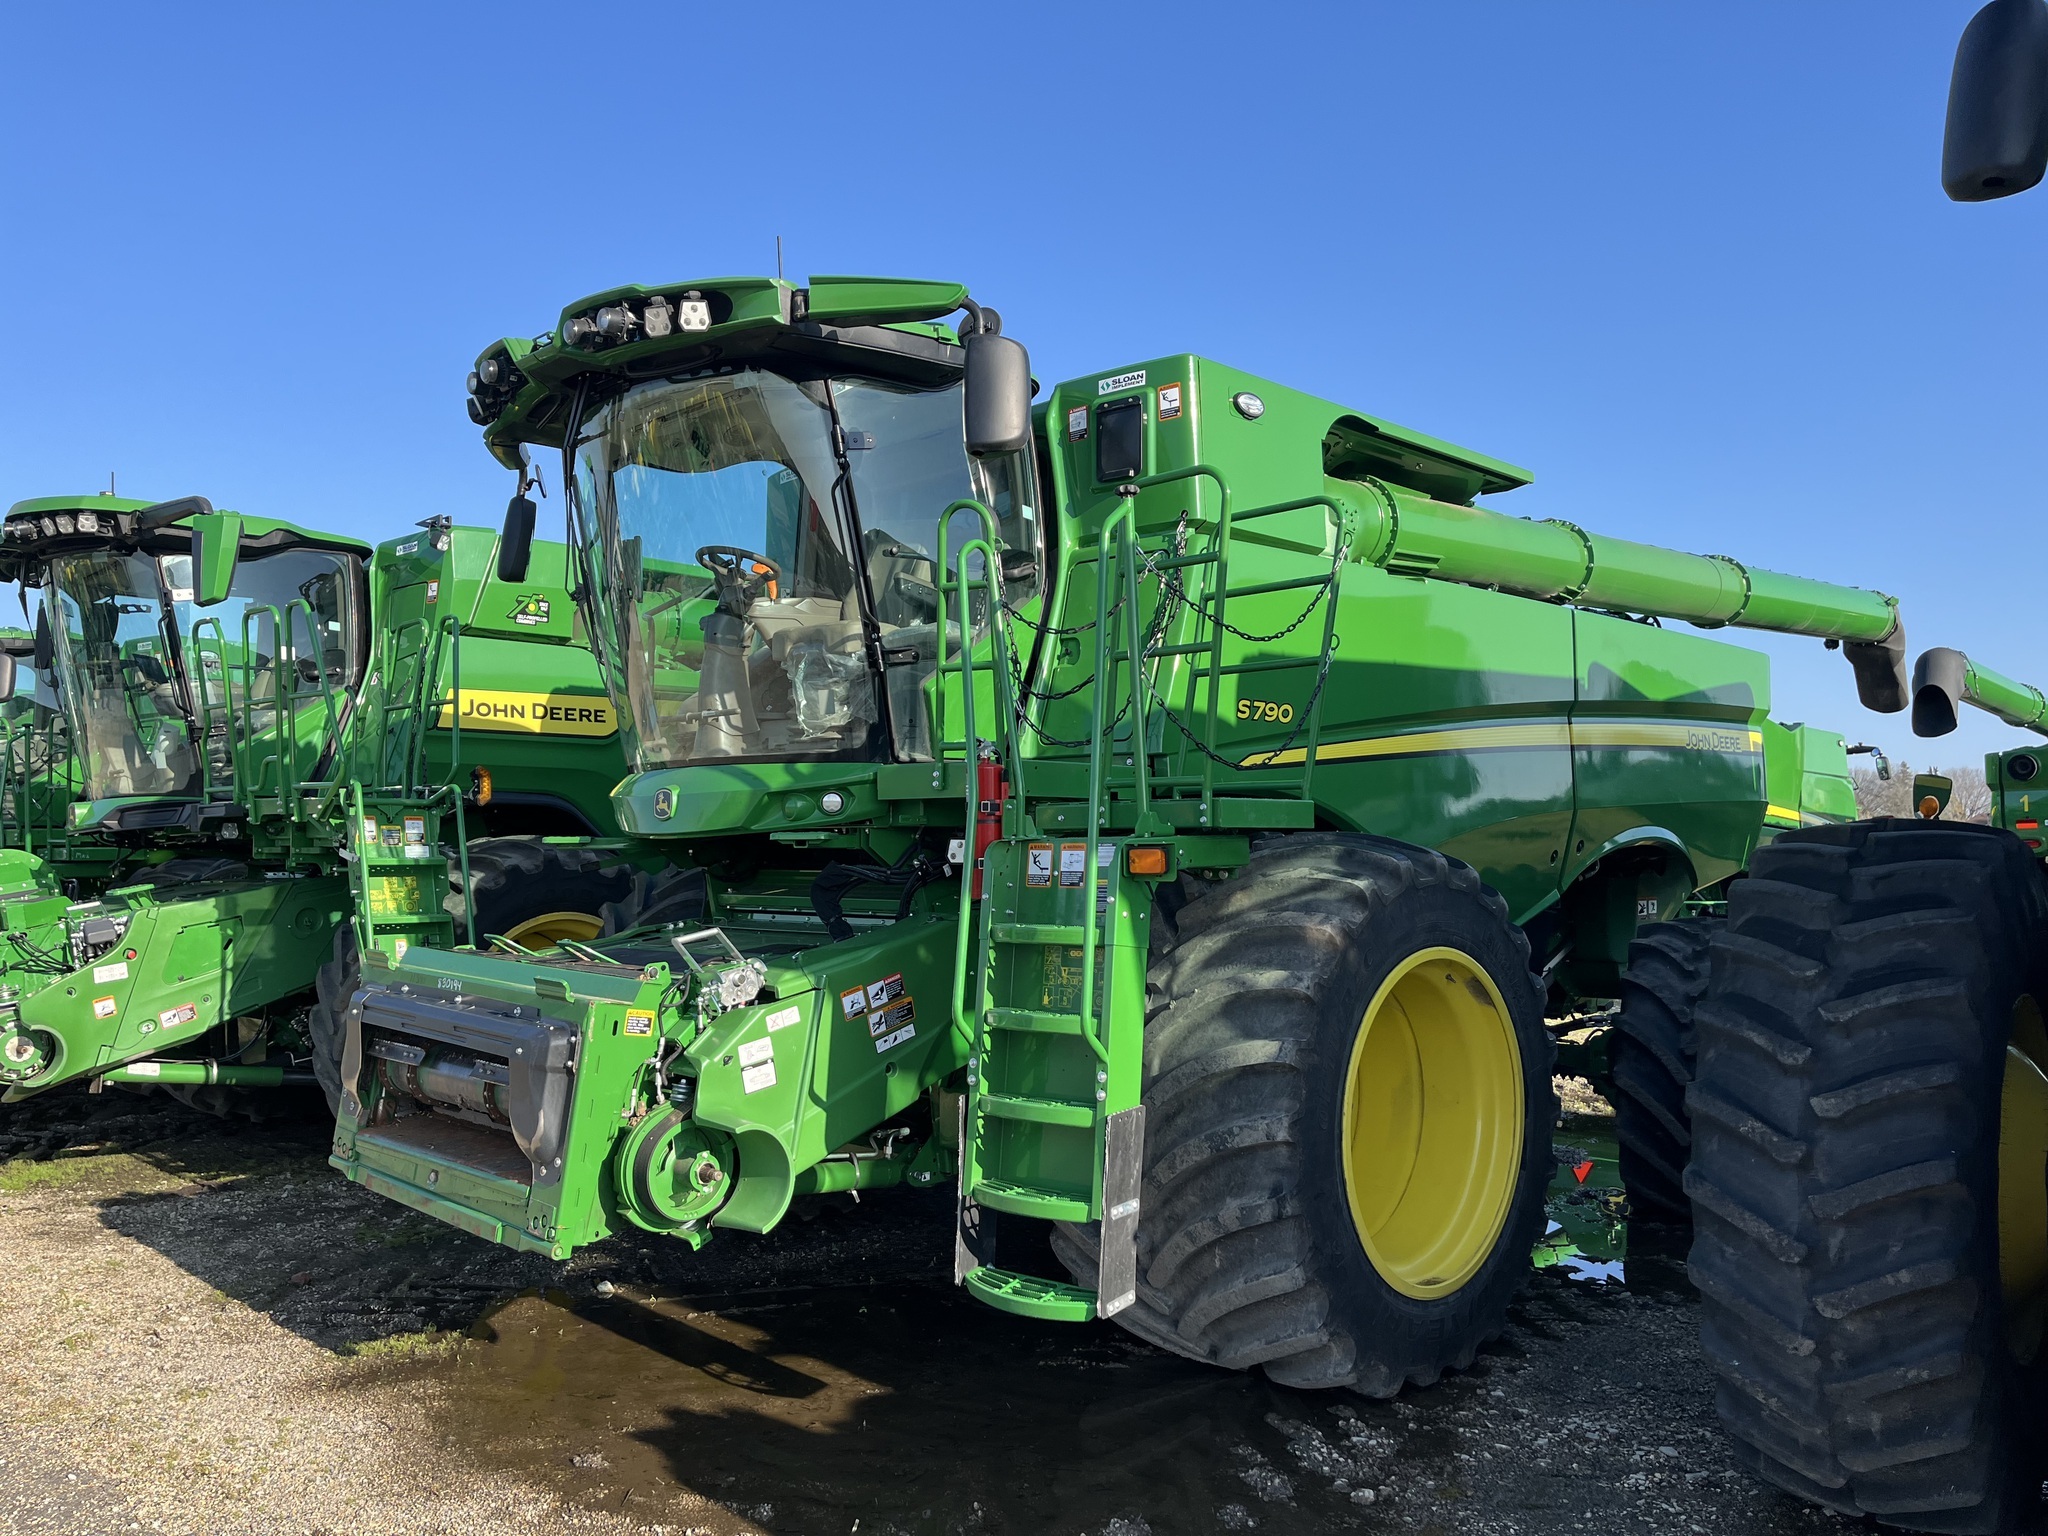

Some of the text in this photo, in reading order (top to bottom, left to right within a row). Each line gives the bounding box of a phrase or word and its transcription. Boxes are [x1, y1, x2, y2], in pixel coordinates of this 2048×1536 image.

[1111, 373, 1144, 386] SLOAN
[1111, 380, 1144, 390] IMPLEMENT
[462, 699, 606, 723] JOHN DEERE
[1237, 699, 1294, 724] S790
[1685, 730, 1742, 752] JOHN DEERE
